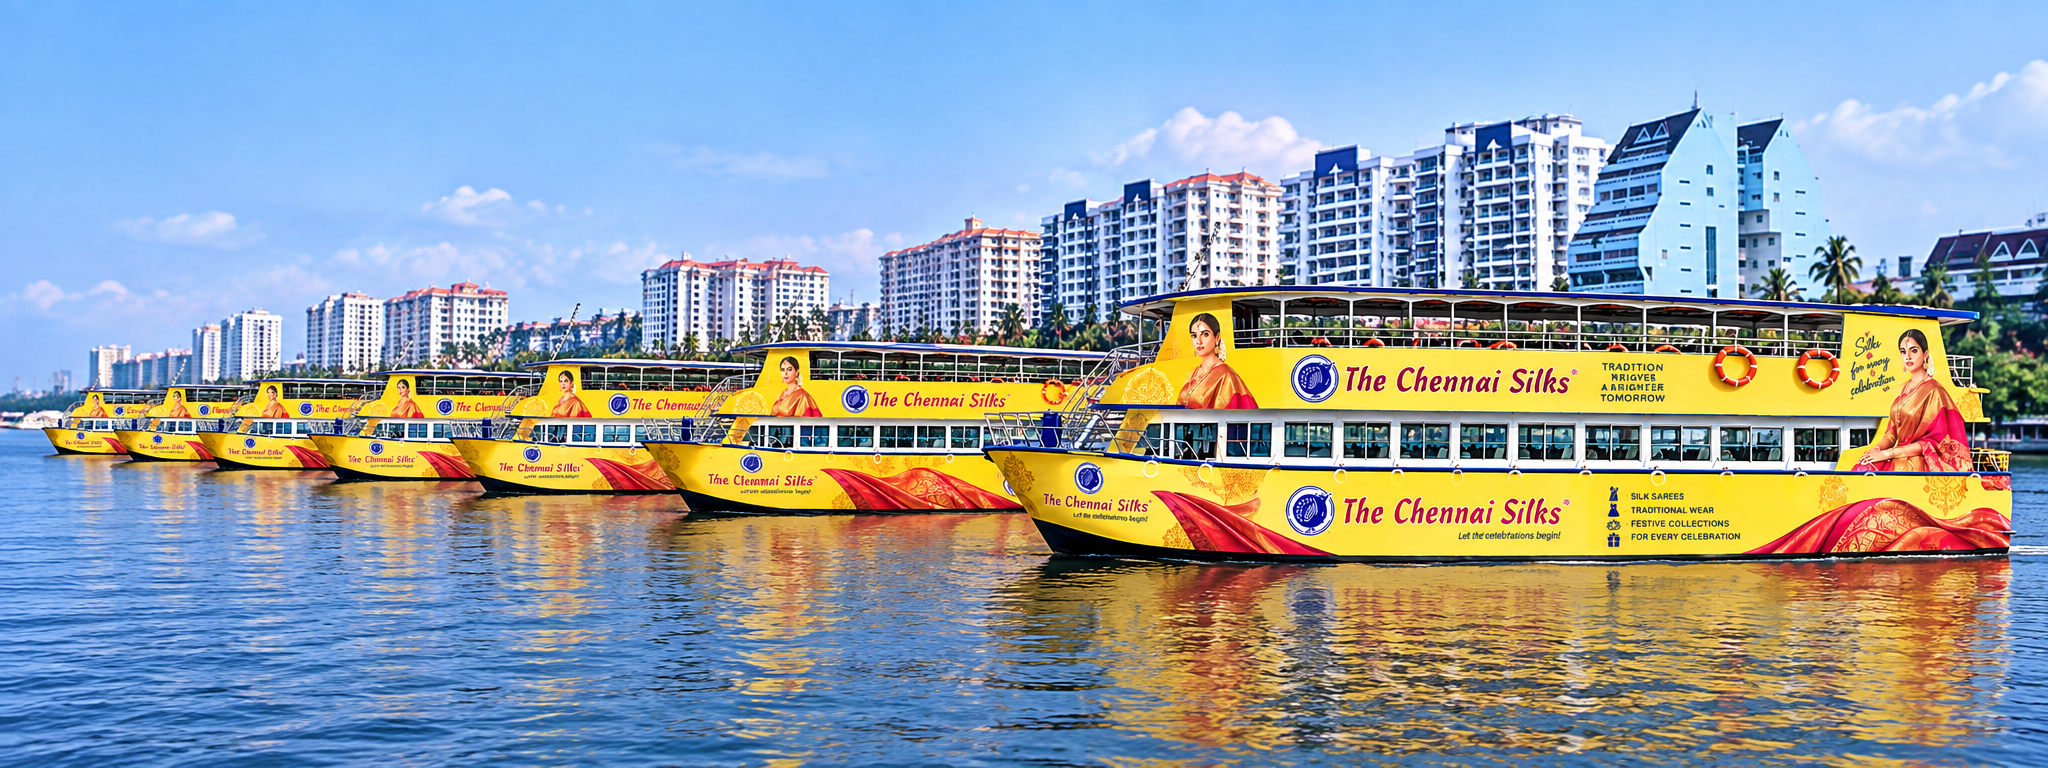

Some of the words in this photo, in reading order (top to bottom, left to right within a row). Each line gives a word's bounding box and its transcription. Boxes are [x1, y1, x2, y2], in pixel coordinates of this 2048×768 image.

[1346, 365, 1387, 393] The
[1396, 365, 1502, 394] Chennai
[1600, 383, 1608, 392] A
[873, 391, 898, 408] The
[903, 391, 966, 408] Chennai
[1600, 393, 1666, 402] TOMORROW
[632, 397, 653, 411] The
[1630, 492, 1650, 501] SILK
[1651, 492, 1685, 501] SAREES
[1043, 493, 1062, 506] The
[1065, 495, 1114, 512] Chennai
[1117, 498, 1149, 513] Silks
[1343, 496, 1384, 525] The
[1393, 496, 1496, 525] Chennai
[1630, 506, 1688, 514] TRADITIONAL
[1689, 506, 1715, 515] WEAR
[1630, 519, 1666, 528] FESTIVE
[1668, 519, 1730, 528] COLLECTIONS
[1536, 531, 1562, 541] begin!
[1630, 532, 1649, 541] FOR
[1650, 532, 1679, 541] EVERY
[1680, 532, 1741, 541] CELEBRATION
